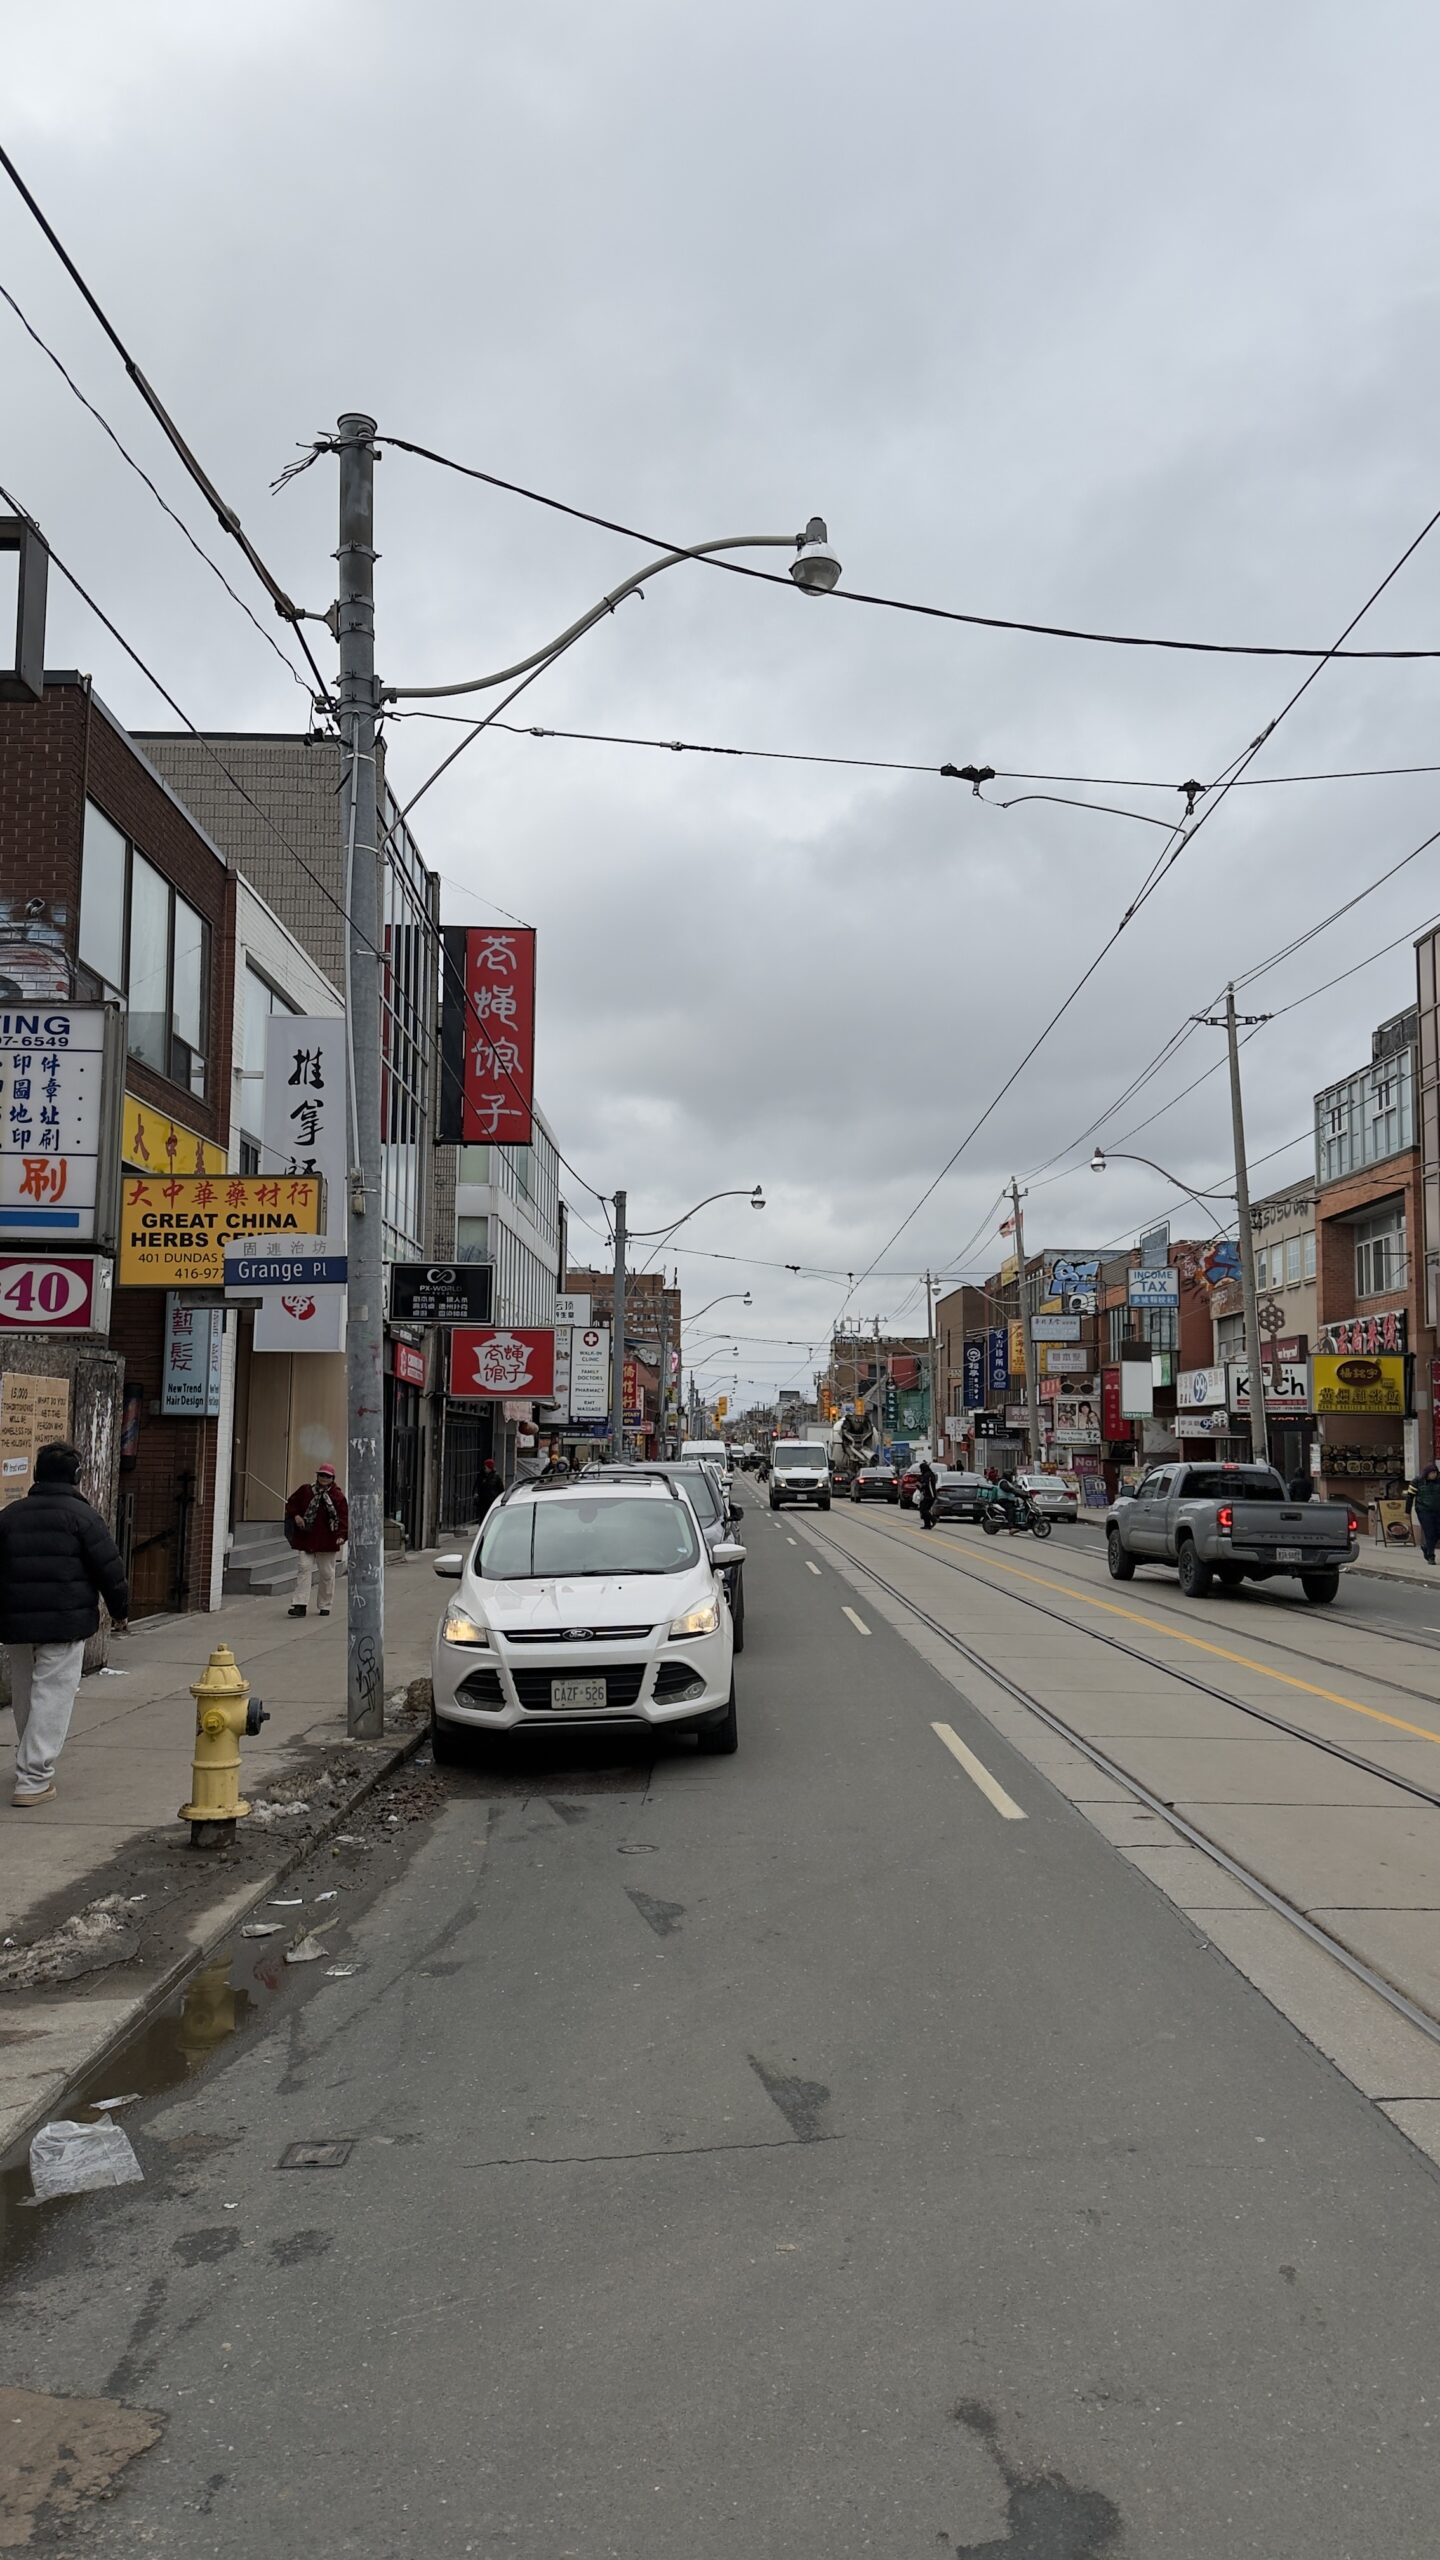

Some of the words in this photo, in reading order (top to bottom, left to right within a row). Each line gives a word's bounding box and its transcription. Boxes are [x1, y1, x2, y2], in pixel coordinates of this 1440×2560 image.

[0, 1015, 71, 1035] ING
[0, 1036, 69, 1047] 7-6549
[0, 1053, 60, 1077] 印件
[0, 1078, 61, 1103] 圖章
[0, 1103, 60, 1125] 地址
[0, 1128, 60, 1151] 印刷
[126, 1179, 314, 1209] 大中華藥材行
[141, 1213, 219, 1229] GREAT
[225, 1213, 298, 1229] CHINA
[131, 1232, 209, 1248] HERBS
[138, 1253, 159, 1264] 401
[164, 1253, 218, 1263] DUNDAS
[238, 1261, 303, 1281] Grange
[313, 1262, 327, 1276] Pl
[1134, 1271, 1173, 1279] INCOME
[1140, 1281, 1167, 1292] TAX
[168, 1384, 182, 1393] New
[183, 1383, 202, 1393] Trend
[166, 1395, 180, 1406] Hair
[181, 1395, 204, 1408] Design
[554, 1686, 579, 1701] CAZF
[585, 1686, 604, 1701] 526
